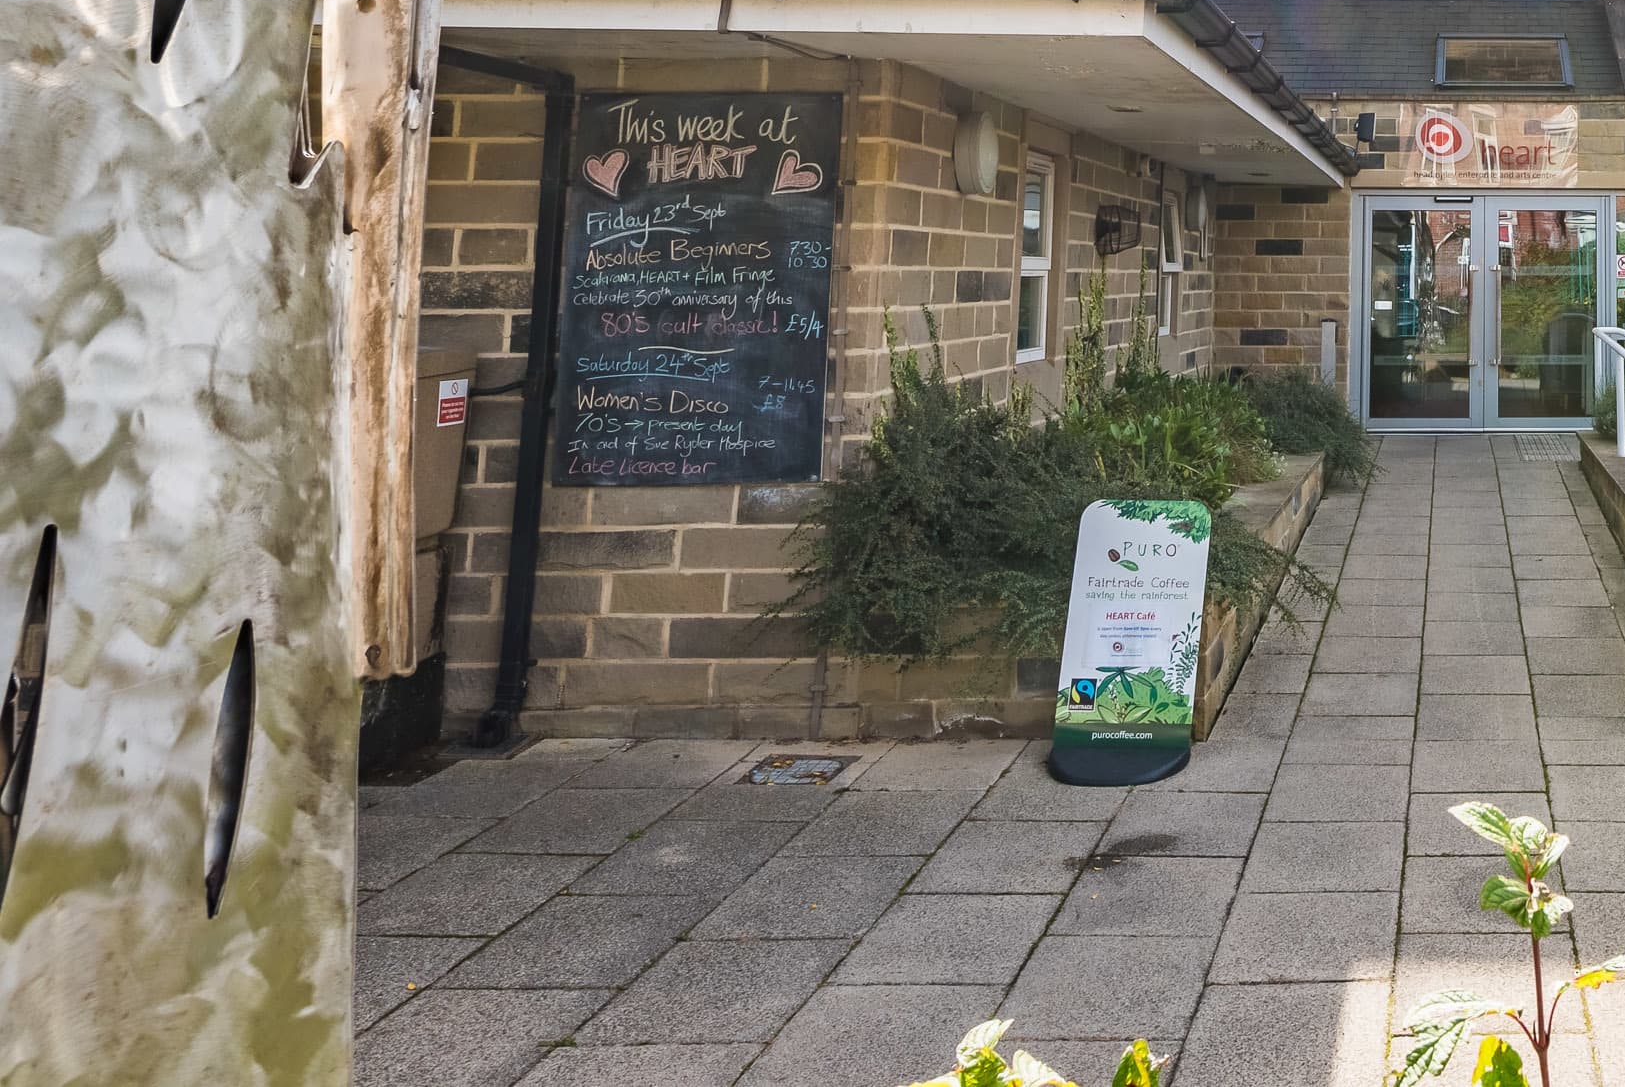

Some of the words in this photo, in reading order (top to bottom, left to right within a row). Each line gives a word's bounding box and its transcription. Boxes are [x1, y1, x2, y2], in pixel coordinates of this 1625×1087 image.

[608, 98, 666, 144] This
[678, 105, 745, 143] week
[758, 105, 799, 144] at
[647, 143, 757, 184] HEART
[1481, 139, 1557, 167] heart
[586, 207, 651, 248] Friday
[690, 201, 727, 232] Sept
[585, 243, 662, 272] Absolute
[670, 238, 772, 271] Beginners
[694, 266, 726, 286] Film
[732, 266, 776, 289] Fringe
[573, 288, 630, 306] Celebrate
[671, 290, 738, 320] anniversary
[745, 288, 761, 314] of
[765, 290, 794, 305] this
[601, 312, 650, 337] 80's
[660, 312, 703, 334] cult
[576, 351, 651, 382] Saturday
[693, 357, 731, 384] Sept
[577, 385, 663, 413] Women's
[669, 389, 730, 414] Disco
[575, 412, 622, 433] 70's
[647, 416, 706, 436] present
[709, 420, 743, 446] day
[567, 439, 588, 453] In
[596, 437, 619, 449] aid
[624, 436, 639, 456] of
[643, 437, 670, 451] Sue
[674, 434, 715, 458] Ryder
[719, 435, 777, 457] Hospice
[567, 456, 616, 476] Late
[680, 458, 717, 475] bar
[1122, 541, 1177, 558] PURO
[1087, 576, 1145, 589] Fairtrade
[1150, 576, 1190, 589] Coffee
[1085, 590, 1116, 602] saving
[1120, 590, 1136, 600] the
[1141, 591, 1189, 601] rainforest
[1105, 612, 1135, 621] HEART
[1136, 610, 1157, 621] Café
[1091, 729, 1153, 741] purocoffee.com
